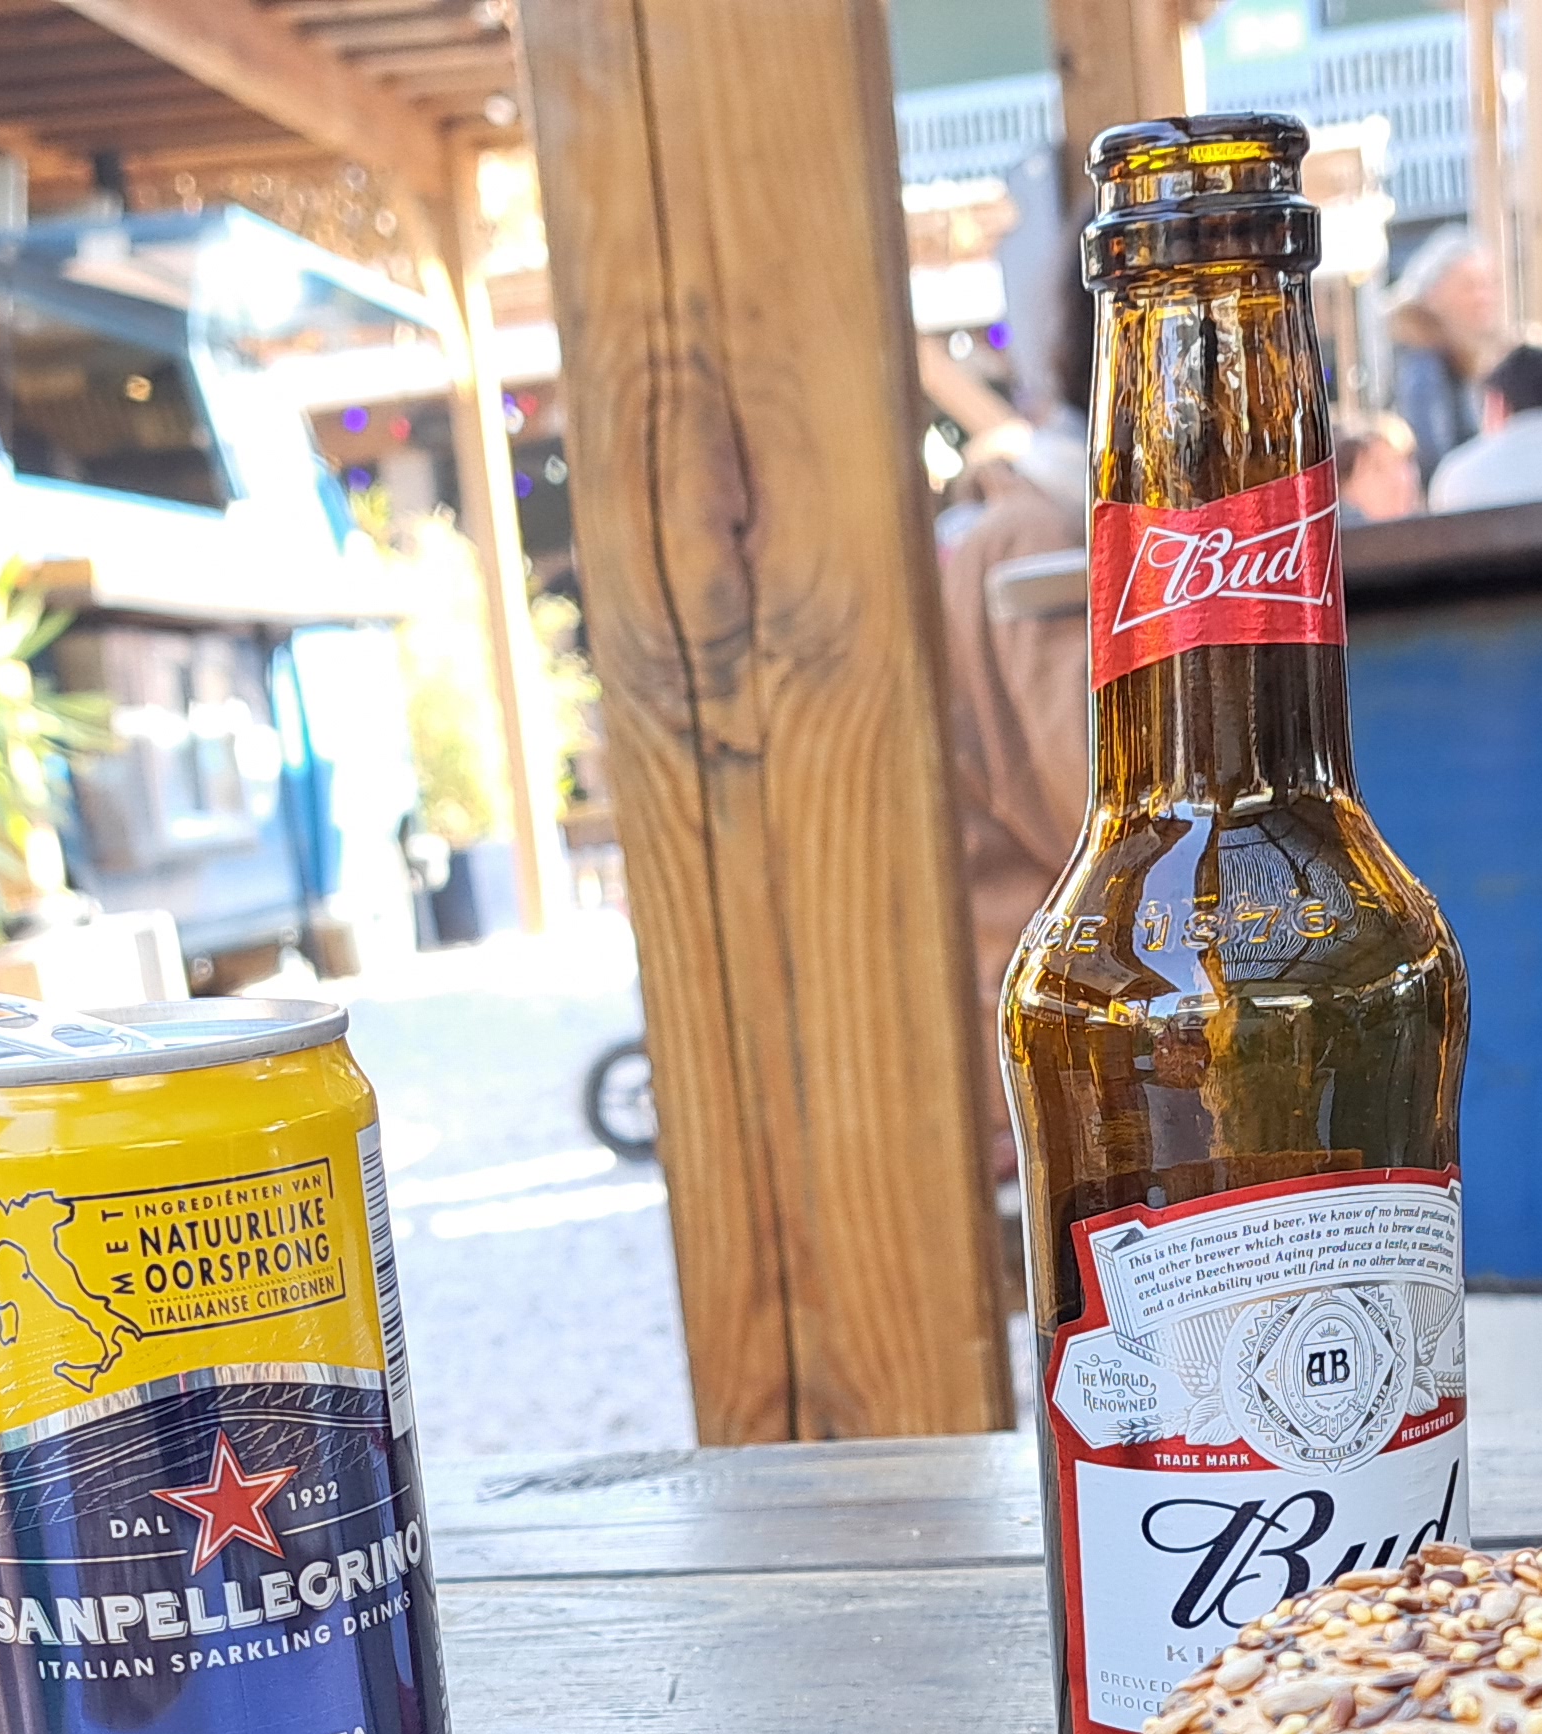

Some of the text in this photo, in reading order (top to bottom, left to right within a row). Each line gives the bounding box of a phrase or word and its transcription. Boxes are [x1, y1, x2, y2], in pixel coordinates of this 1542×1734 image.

[1148, 521, 1307, 605] Bud
[135, 1174, 322, 1219] INGREDIËNTEN VAN
[101, 1208, 136, 1295] MET
[139, 1197, 326, 1257] NATUURLIJKE
[1129, 1254, 1152, 1270] This
[1154, 1248, 1165, 1260] is
[1167, 1240, 1187, 1256] the
[1190, 1230, 1238, 1250] famous
[1242, 1220, 1269, 1237] Bud
[1308, 1212, 1326, 1224] We
[1330, 1209, 1363, 1222] know
[1364, 1205, 1378, 1220] of
[1378, 1208, 1391, 1217] no
[1394, 1204, 1420, 1217] brand
[145, 1232, 330, 1293] OORSPRONG
[1134, 1270, 1155, 1286] any
[1158, 1257, 1191, 1276] other
[1195, 1244, 1240, 1264] brewer
[1245, 1233, 1284, 1253] which
[1289, 1229, 1322, 1244] costs
[1325, 1227, 1340, 1238] so
[1344, 1222, 1375, 1236] much
[1377, 1221, 1389, 1233] to
[1391, 1221, 1415, 1234] brew
[1138, 1275, 1192, 1301] exclusive
[1195, 1253, 1270, 1283] Beechwood
[1275, 1248, 1313, 1264] Aging
[1318, 1241, 1372, 1258] produces
[1374, 1242, 1382, 1250] a
[150, 1275, 335, 1326] ITALIAANSE CITROENEN
[1142, 1301, 1164, 1318] and
[1166, 1298, 1175, 1308] a
[1177, 1275, 1252, 1305] drinkability
[1255, 1270, 1279, 1288] you
[1284, 1263, 1306, 1278] will
[1308, 1258, 1334, 1276] find
[1338, 1257, 1349, 1269] in
[1353, 1257, 1367, 1267] no
[1369, 1255, 1396, 1267] other
[1259, 1312, 1292, 1355] AUSTRALIA
[1074, 1364, 1156, 1396] THE WORLD
[1306, 1348, 1351, 1387] AB
[1083, 1388, 1157, 1413] RENOWNED
[1263, 1397, 1291, 1430] AFRICA
[1371, 1384, 1389, 1415] ASIA
[1306, 1441, 1357, 1459] AMERICA
[1401, 1411, 1454, 1442] REGISTERED
[1154, 1452, 1251, 1468] TRADE MARK
[110, 1481, 339, 1540] DAL 1932
[1141, 1457, 1460, 1630] Bud
[38, 1589, 411, 1681] ITALIAN SPARKLING DRINKS
[1100, 1670, 1172, 1693] BREWED
